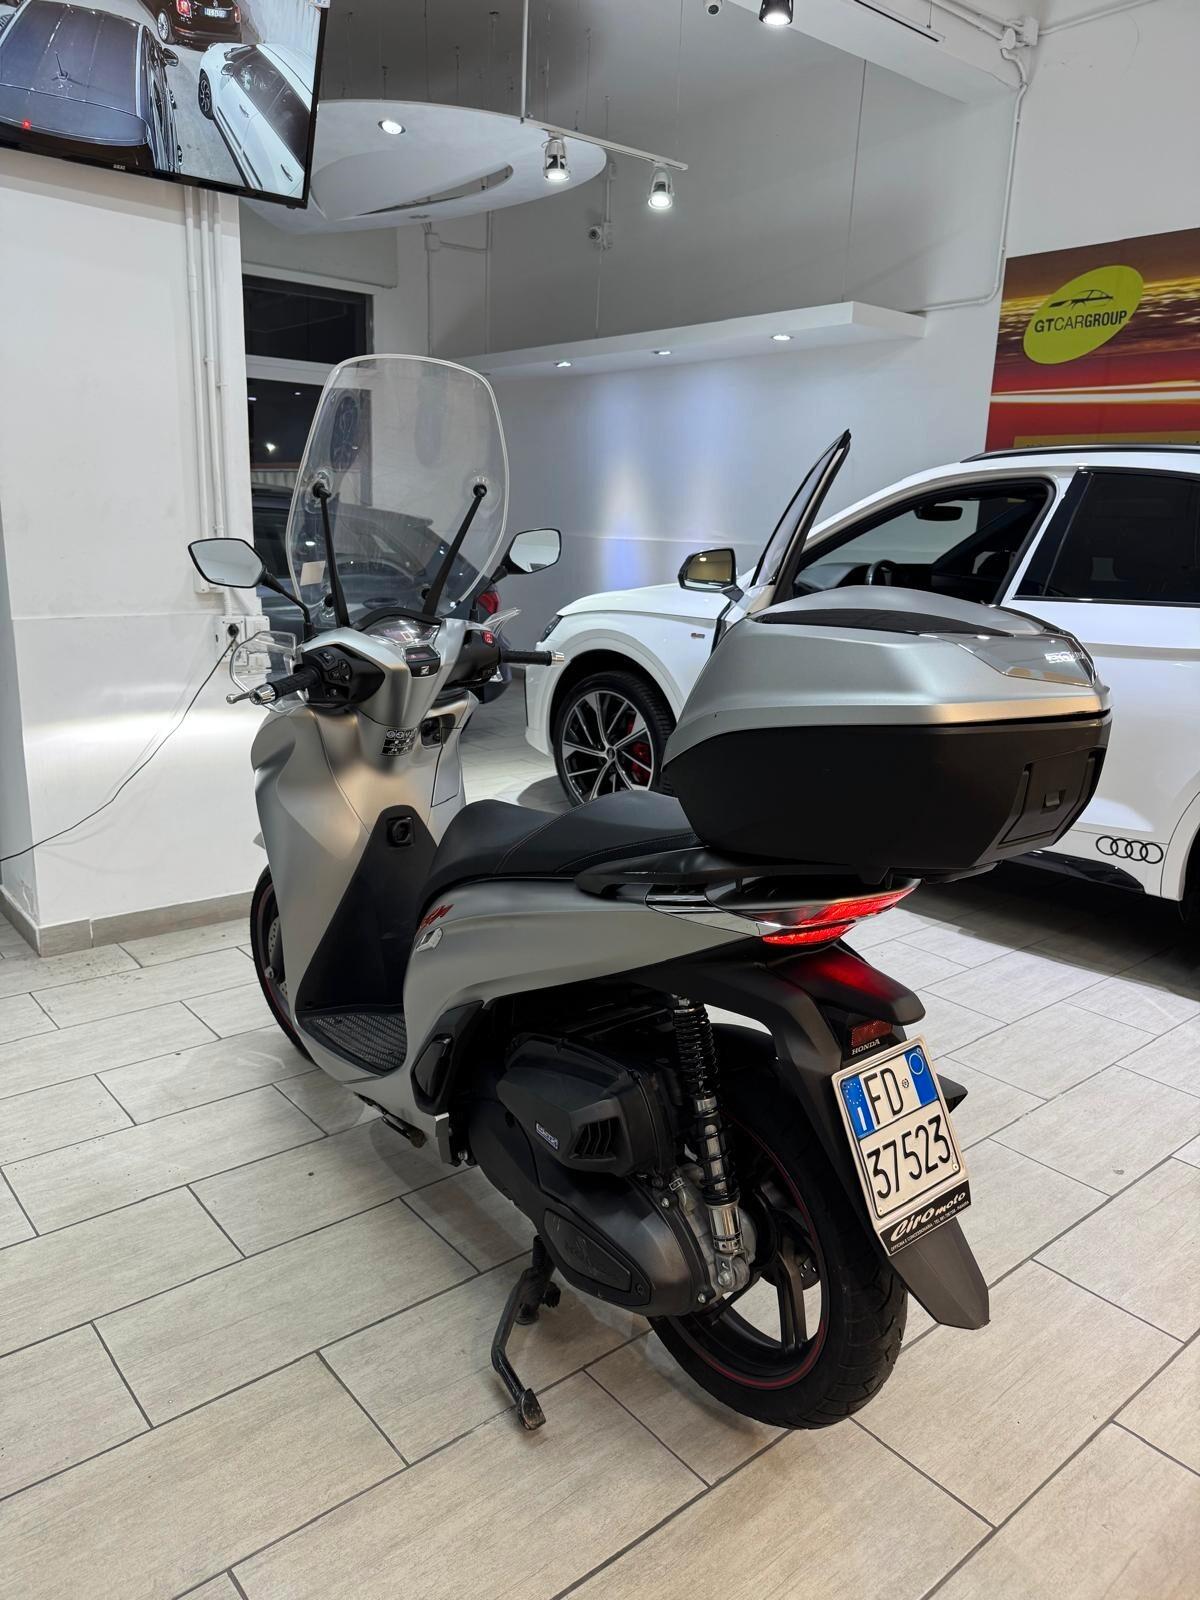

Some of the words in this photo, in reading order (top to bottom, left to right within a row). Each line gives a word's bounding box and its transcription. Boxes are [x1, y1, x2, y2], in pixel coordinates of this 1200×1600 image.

[1034, 310, 1127, 333] GTCARGROUP
[852, 1038, 881, 1055] HONDA
[863, 1067, 904, 1126] FD
[866, 1114, 951, 1199] 37523
[935, 1192, 966, 1216] moto
